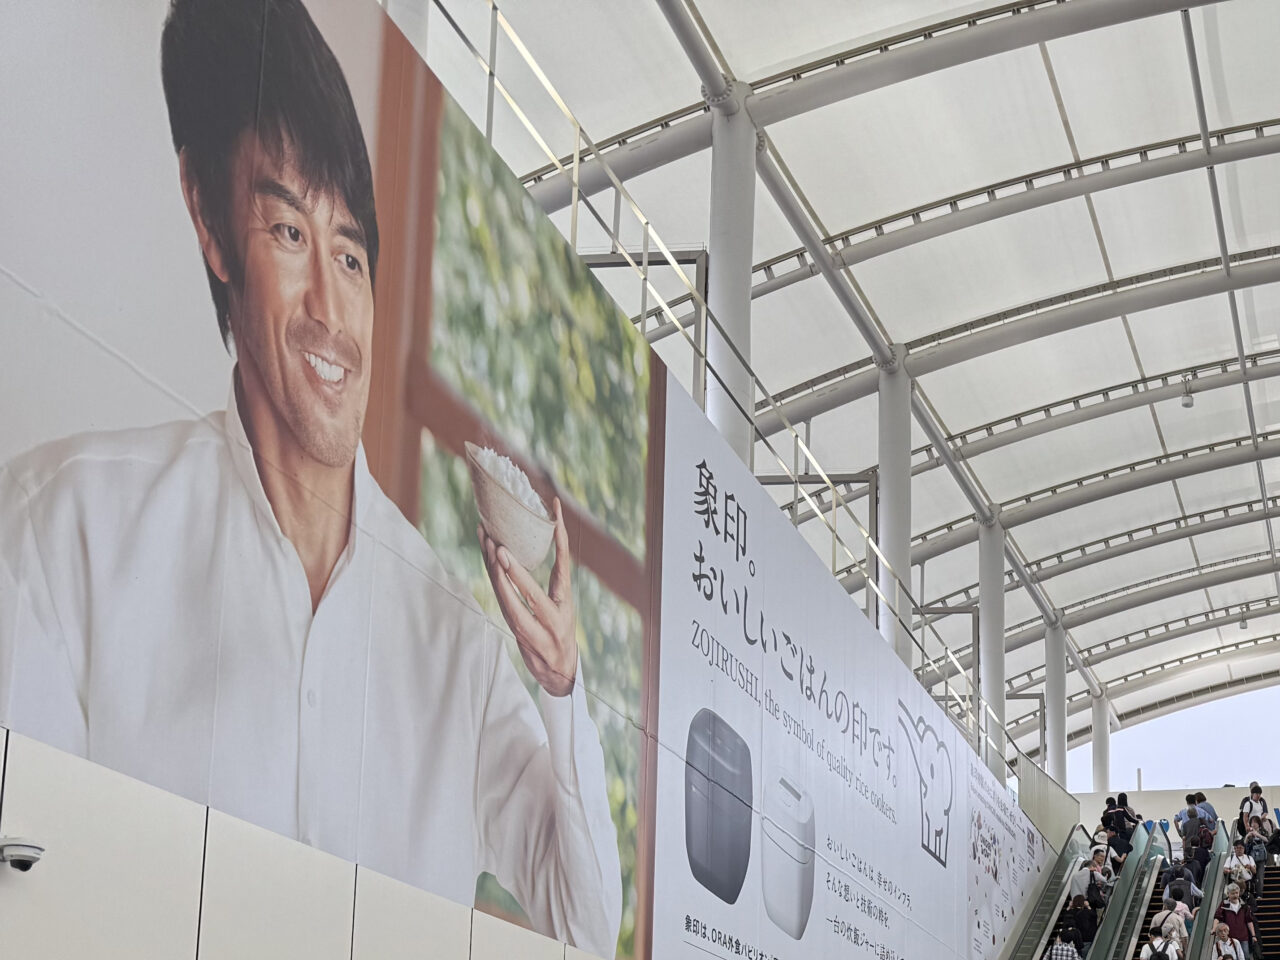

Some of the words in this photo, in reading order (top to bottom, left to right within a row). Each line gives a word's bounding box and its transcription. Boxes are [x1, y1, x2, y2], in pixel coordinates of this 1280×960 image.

[694, 459, 755, 577] 象印。
[691, 619, 761, 707] ZOJIRUSHI,
[764, 688, 780, 720] the
[783, 710, 815, 751] symbol
[816, 738, 825, 761] of
[826, 752, 853, 788] quality
[855, 771, 870, 800] rice
[870, 788, 898, 825] cookers.
[692, 539, 898, 789] おいしいごはんの印です。
